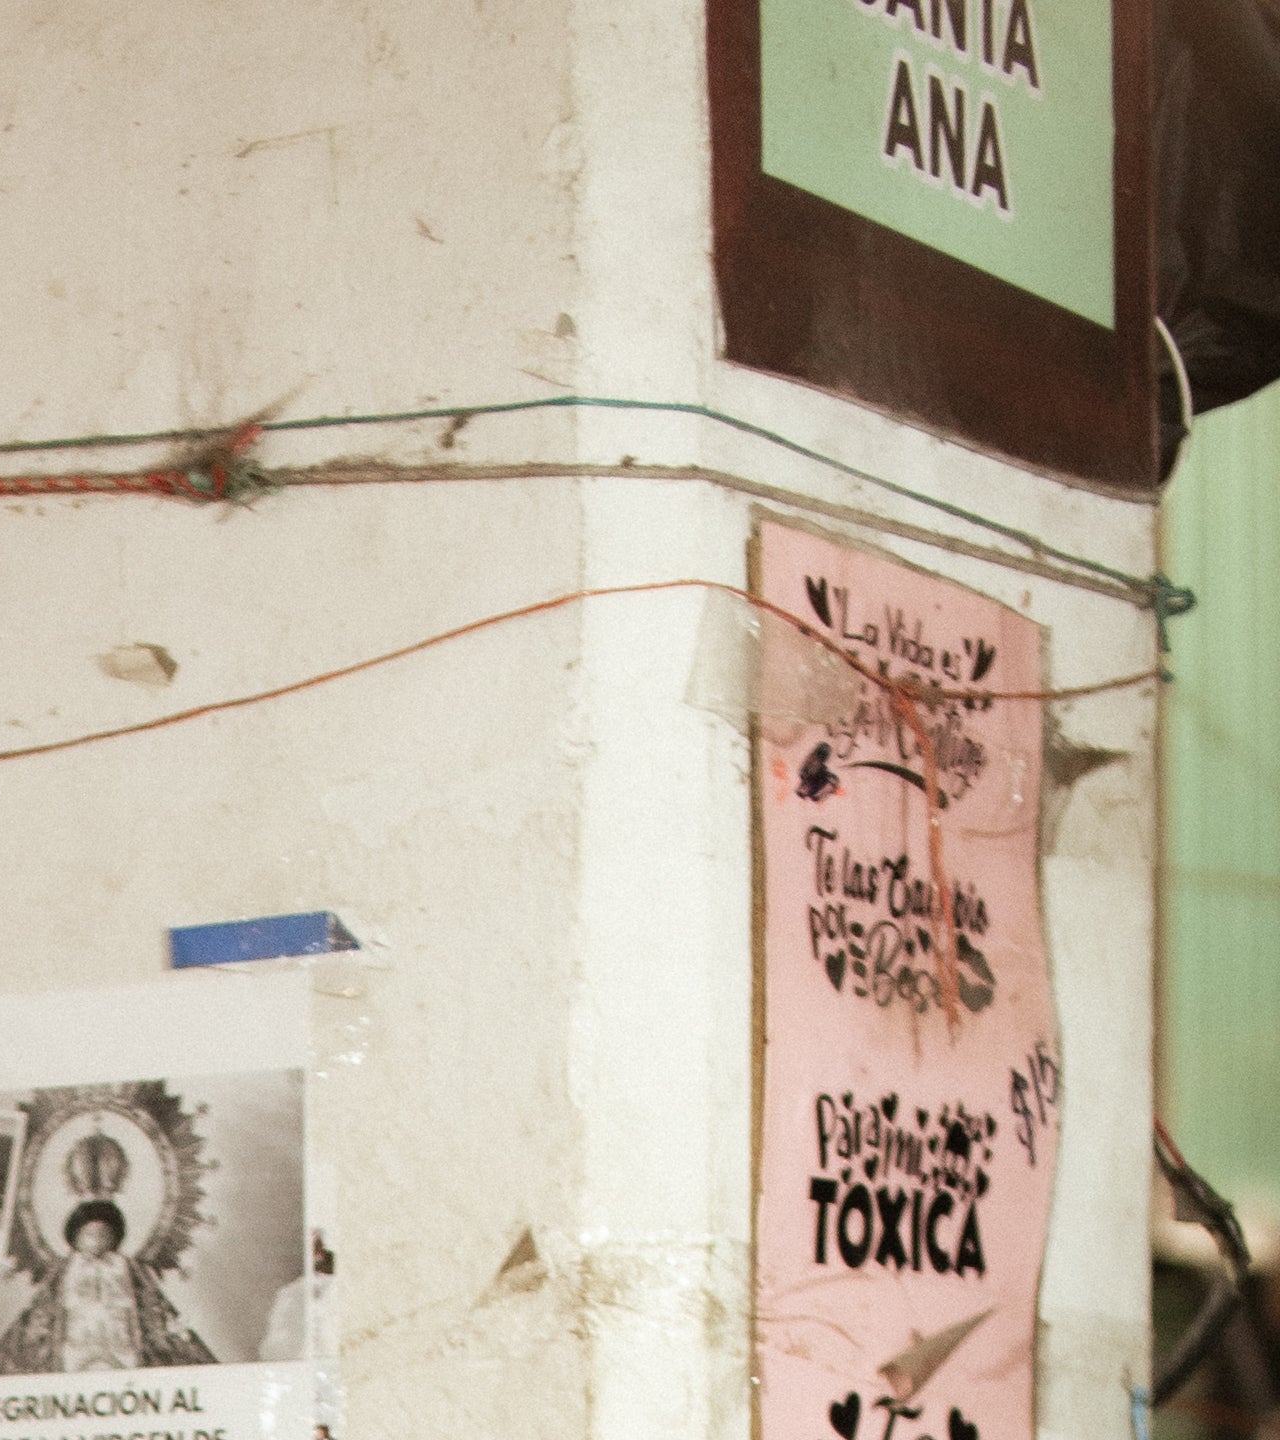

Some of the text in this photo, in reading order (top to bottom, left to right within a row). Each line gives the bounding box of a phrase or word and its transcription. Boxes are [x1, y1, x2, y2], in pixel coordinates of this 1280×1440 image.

[884, 60, 1009, 210] ANA
[816, 1093, 880, 1169] Para
[810, 1177, 986, 1279] TOXICA
[168, 1386, 205, 1414] AL
